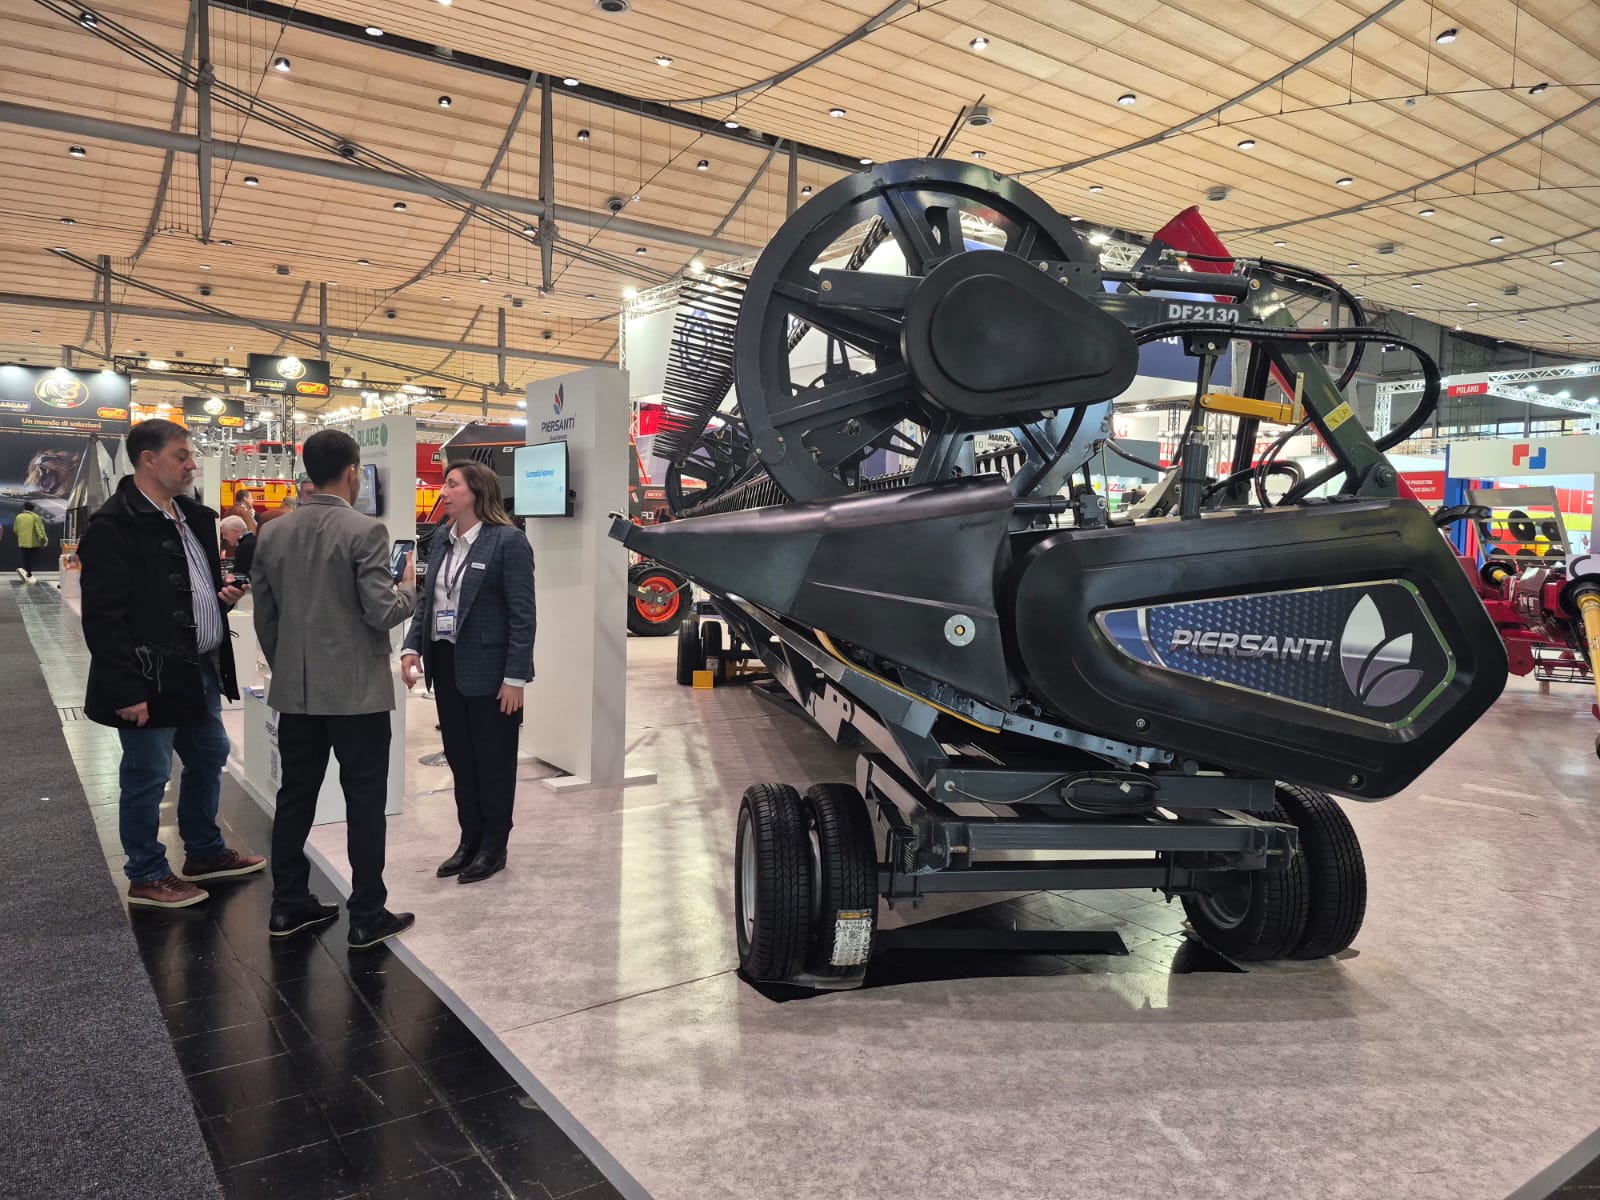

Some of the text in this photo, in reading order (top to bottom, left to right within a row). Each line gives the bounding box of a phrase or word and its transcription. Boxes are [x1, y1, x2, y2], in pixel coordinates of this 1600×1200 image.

[1168, 303, 1240, 323] DF2130
[1456, 384, 1479, 394] POLAND
[0, 401, 29, 409] ARGAM
[541, 417, 575, 433] PIERSANTI
[1170, 629, 1334, 663] PIERSANTI
